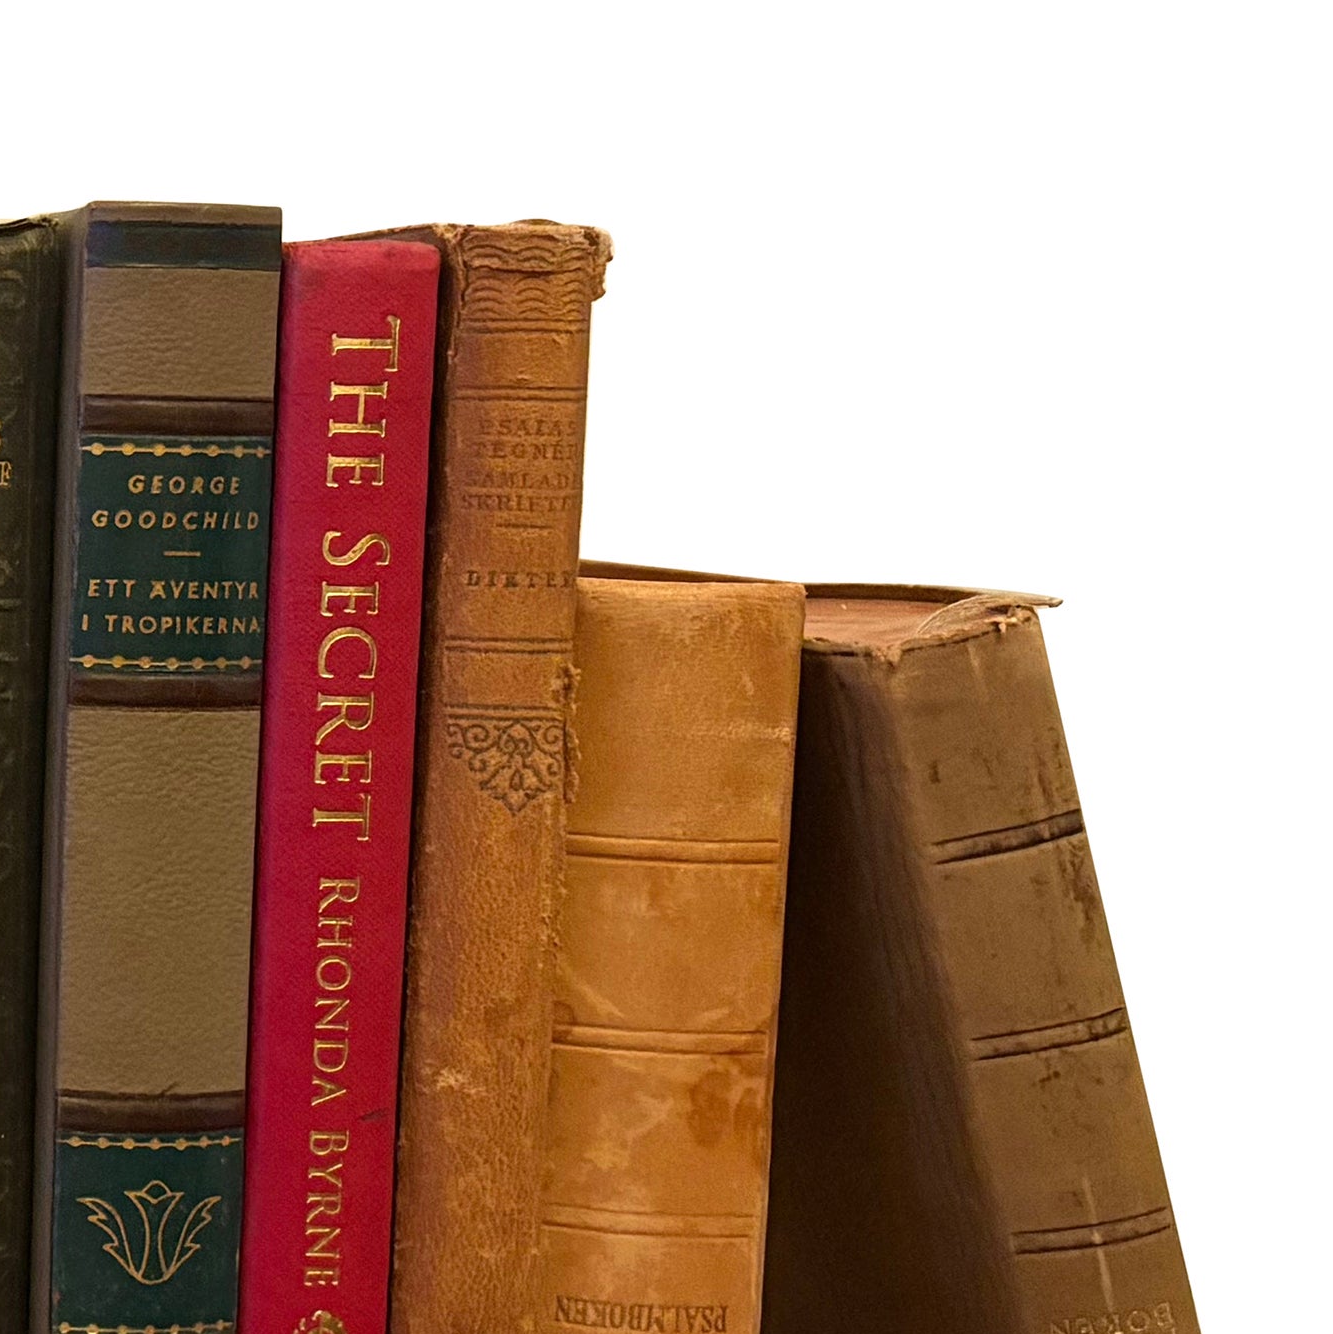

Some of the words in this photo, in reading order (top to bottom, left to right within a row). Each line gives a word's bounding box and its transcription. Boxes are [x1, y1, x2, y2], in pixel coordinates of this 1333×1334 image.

[327, 314, 401, 488] THE
[127, 474, 241, 495] GEORGE
[91, 509, 260, 531] GOODCHILD
[87, 579, 137, 599] ETT
[149, 579, 259, 600] ÄVENTYR
[80, 614, 90, 633] I
[105, 614, 261, 635] TROPIKERNA
[311, 529, 392, 842] SECRET
[311, 875, 362, 1107] RHONDA
[303, 1129, 350, 1287] BYRNE
[554, 1295, 729, 1334] PSALMBOKEN
